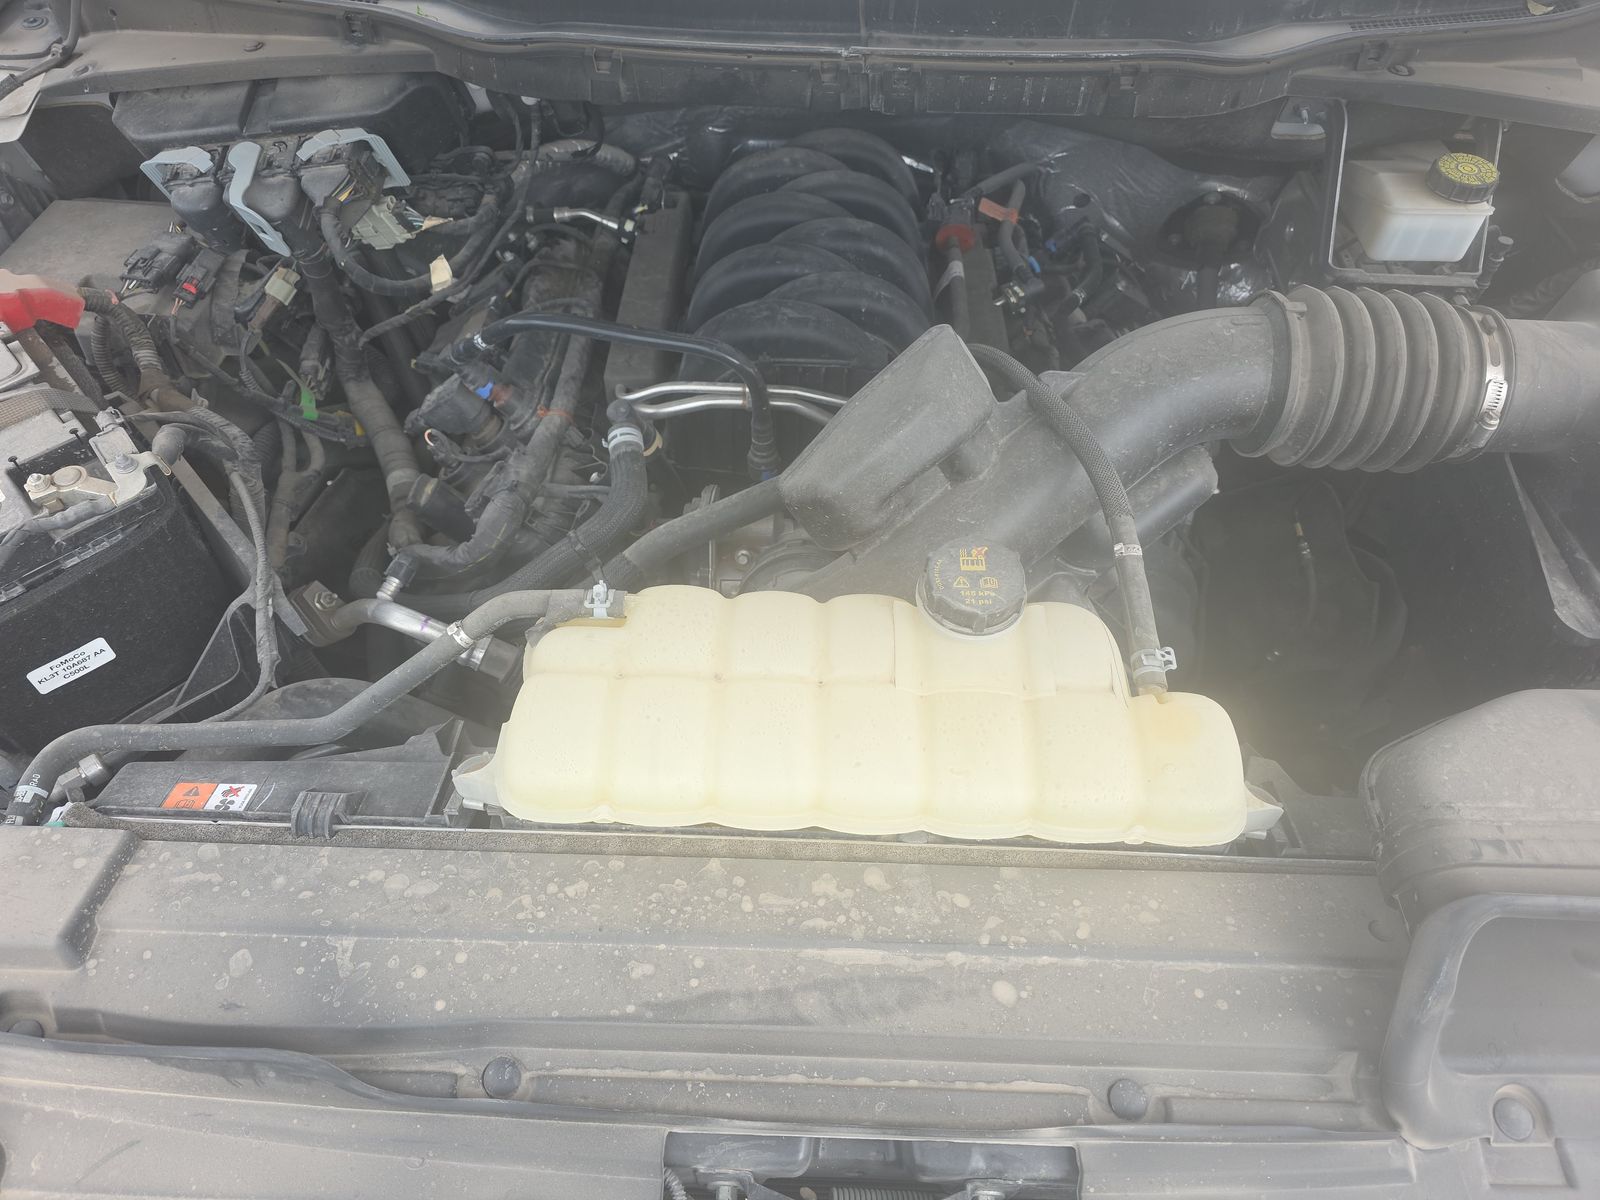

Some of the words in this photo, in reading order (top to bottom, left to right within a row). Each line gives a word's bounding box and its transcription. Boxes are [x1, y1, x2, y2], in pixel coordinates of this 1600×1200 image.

[37, 671, 60, 685] KL3T
[93, 648, 106, 657] AA
[49, 650, 86, 671] FoMoCo
[63, 664, 90, 680] C500L
